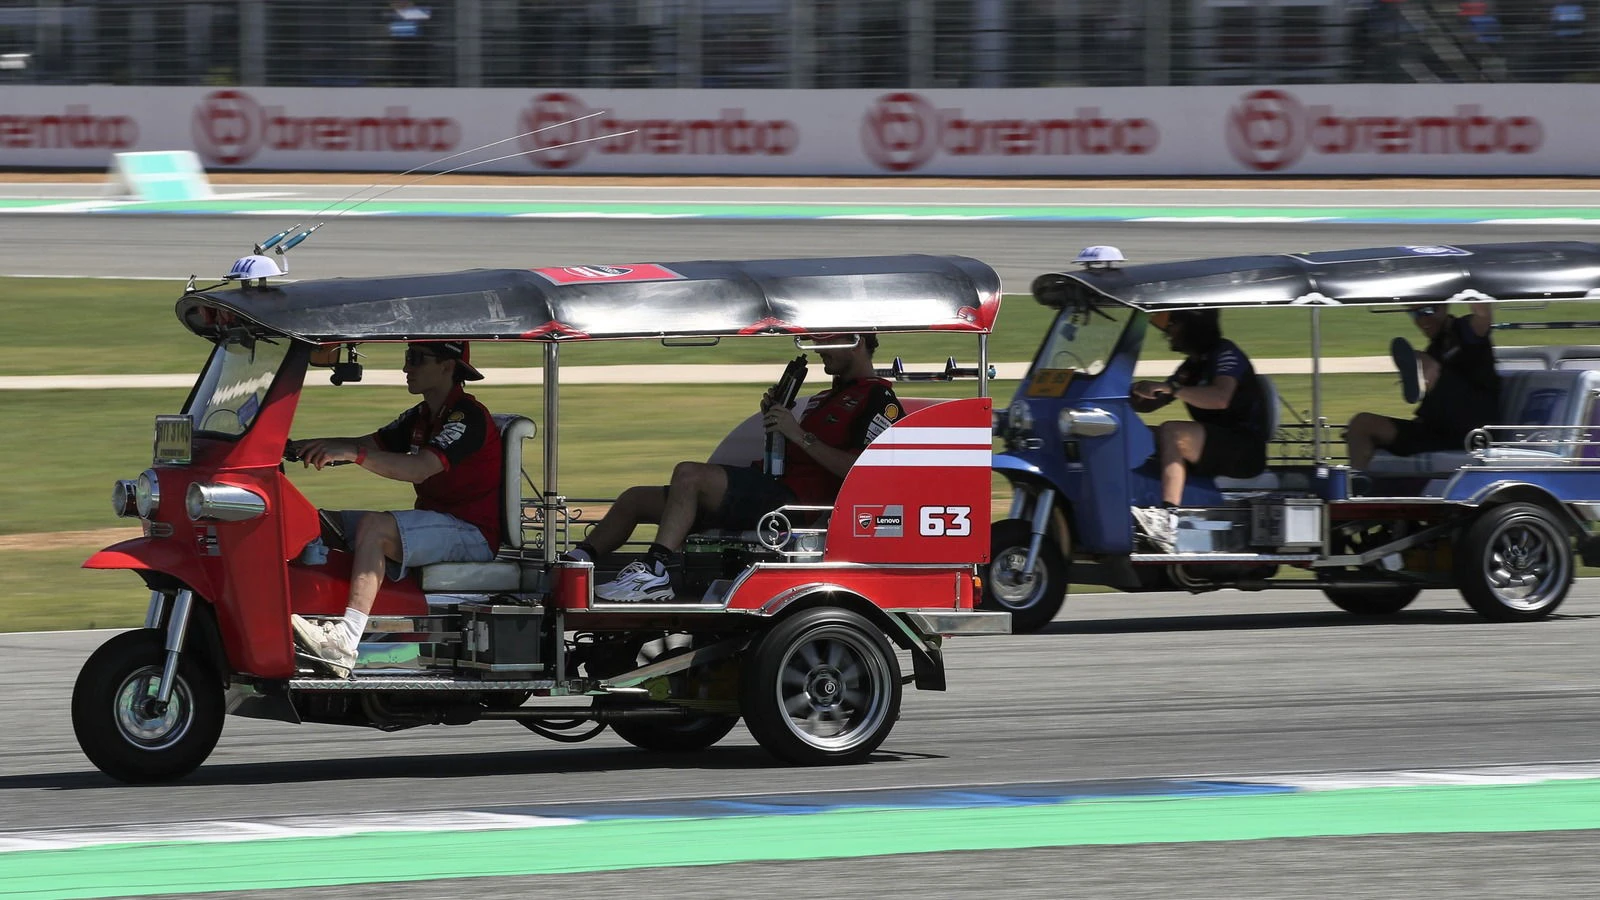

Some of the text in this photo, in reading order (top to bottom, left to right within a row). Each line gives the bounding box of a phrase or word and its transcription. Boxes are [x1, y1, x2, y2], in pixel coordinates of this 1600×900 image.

[262, 106, 462, 151] brembo
[593, 108, 799, 155] brembo
[937, 107, 1160, 155] brembo
[1307, 104, 1544, 153] brembo
[920, 506, 971, 537] 63
